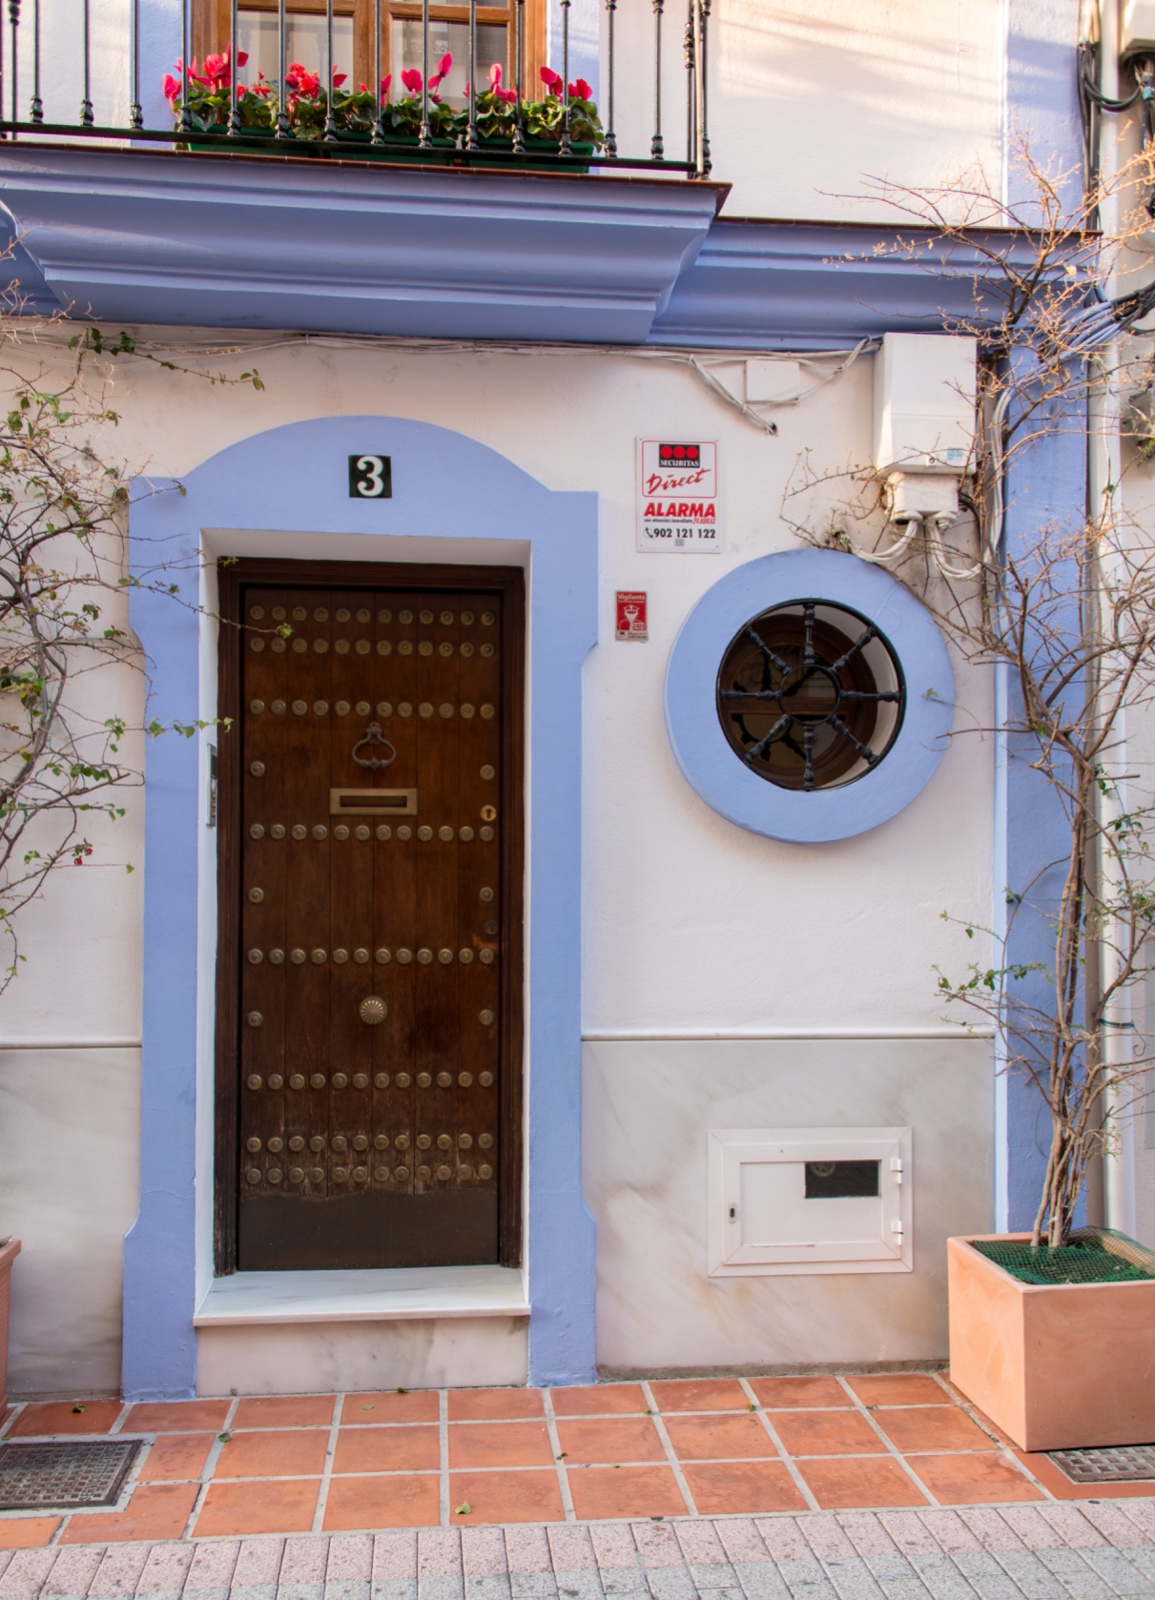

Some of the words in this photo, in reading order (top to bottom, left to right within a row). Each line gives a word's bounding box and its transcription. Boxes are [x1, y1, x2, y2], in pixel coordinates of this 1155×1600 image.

[357, 455, 384, 497] 3
[645, 467, 712, 495] Direct
[643, 502, 716, 518] ALARMA
[653, 528, 673, 538] 902
[676, 528, 693, 538] 121
[698, 529, 716, 539] 122
